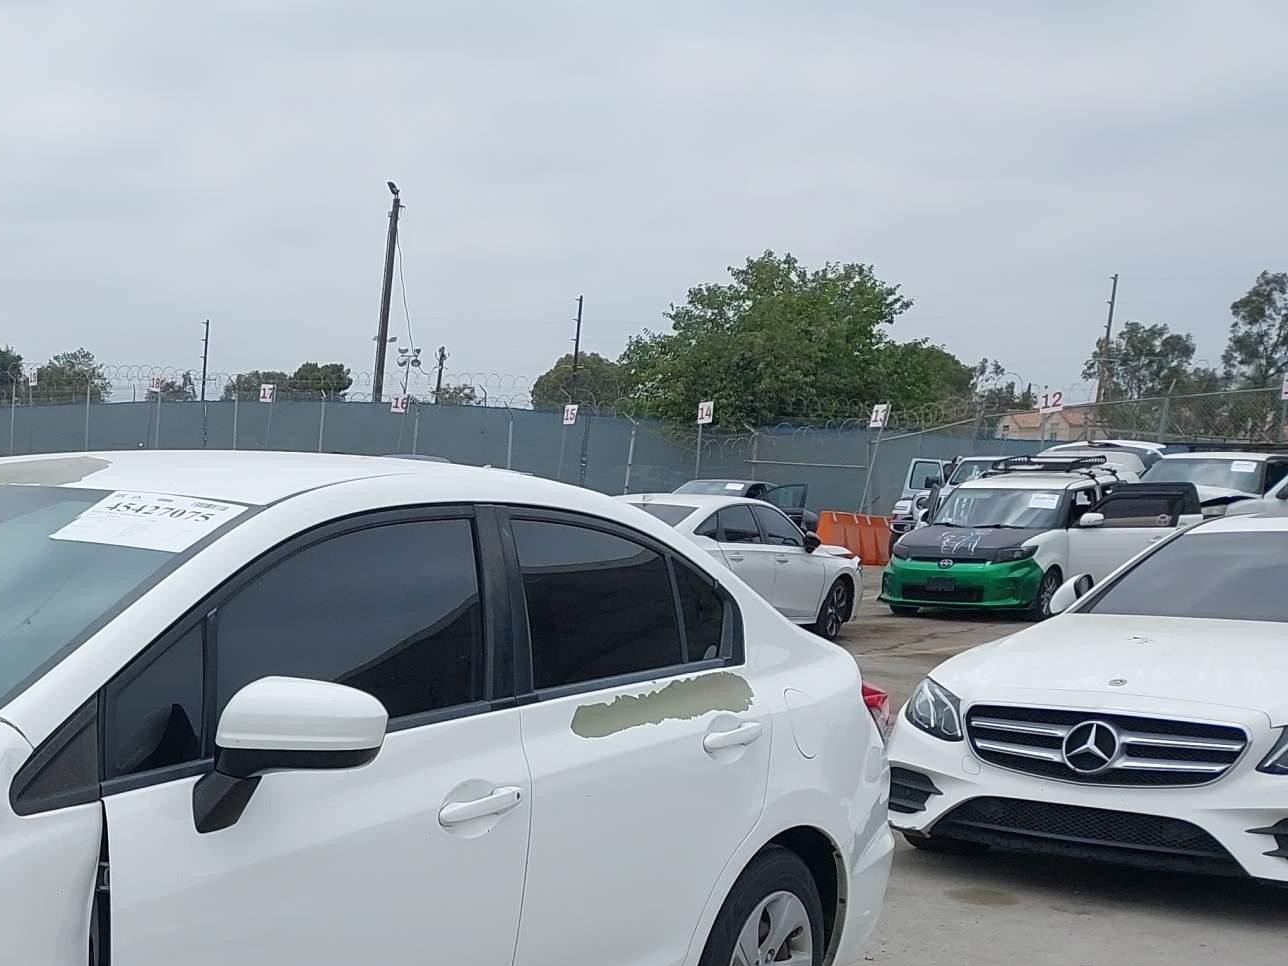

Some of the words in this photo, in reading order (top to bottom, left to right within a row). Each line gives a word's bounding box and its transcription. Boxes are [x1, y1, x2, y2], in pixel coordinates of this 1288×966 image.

[261, 387, 273, 399] 17
[393, 397, 408, 409] 16
[1041, 391, 1063, 409] 12
[565, 408, 576, 420] 15
[699, 408, 711, 420] 14
[105, 501, 215, 522] 45427075
